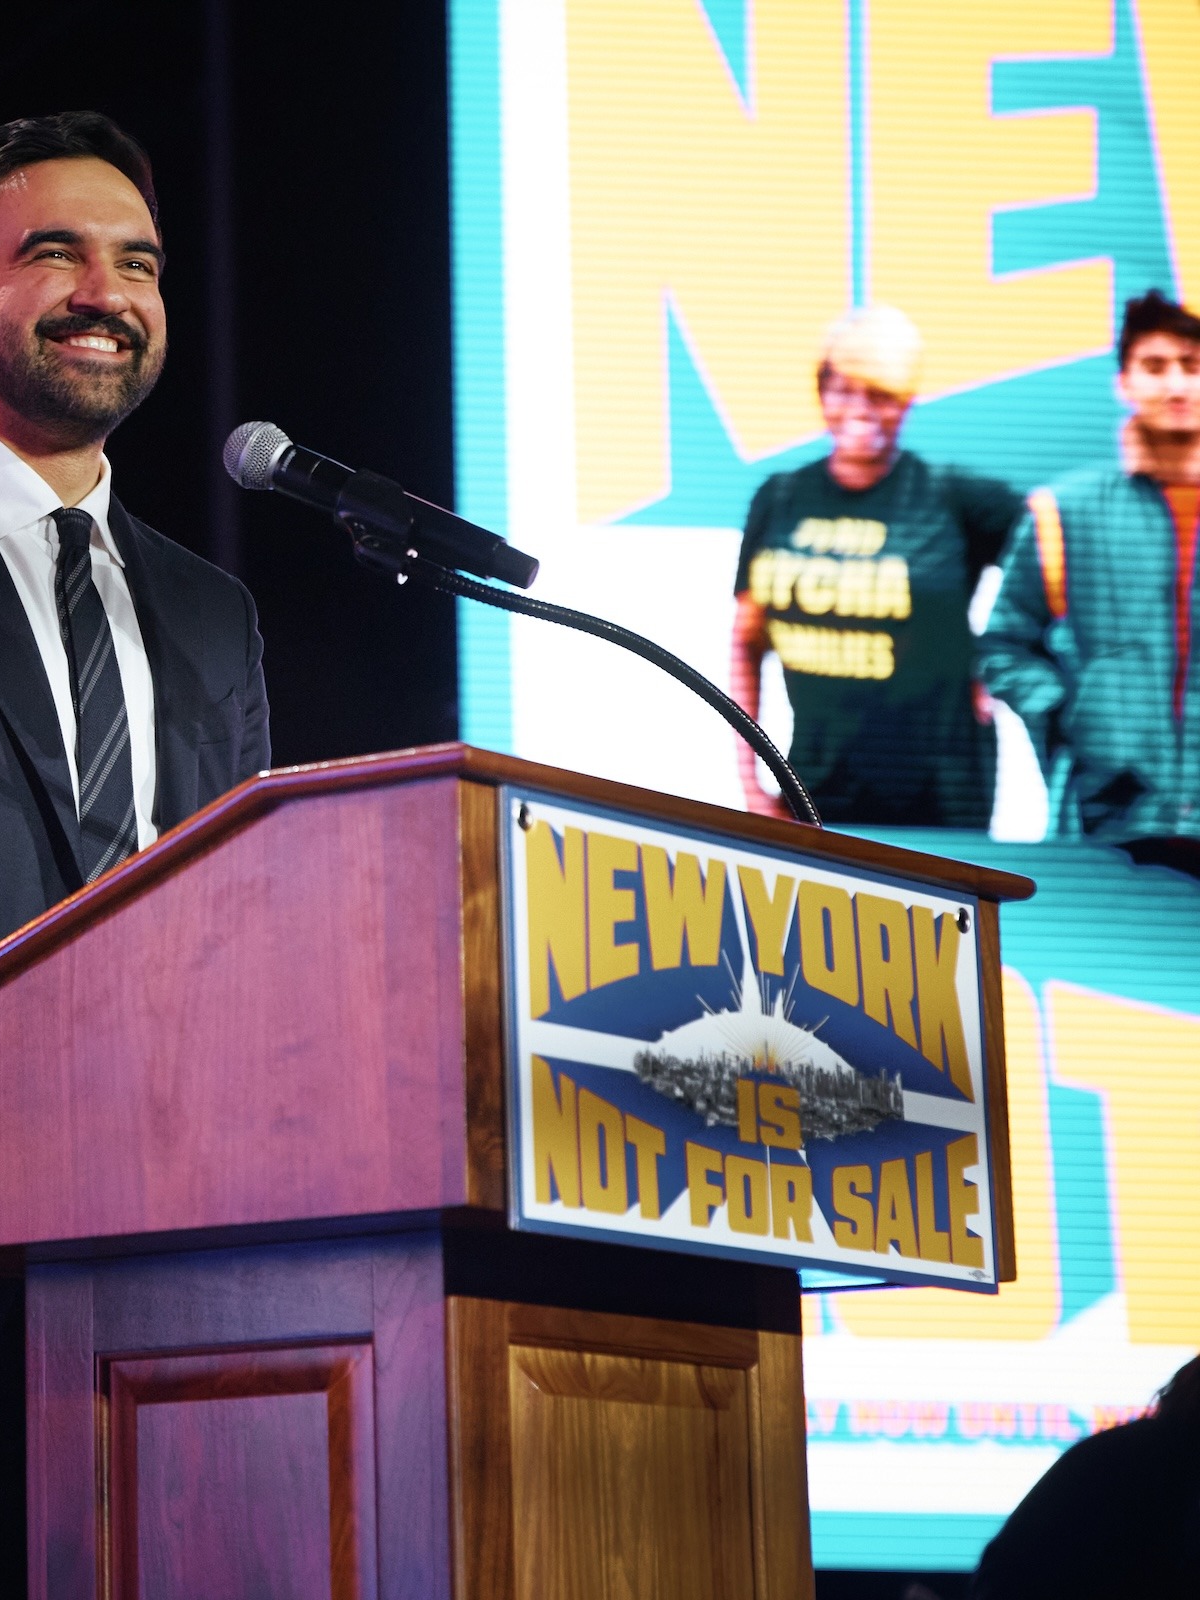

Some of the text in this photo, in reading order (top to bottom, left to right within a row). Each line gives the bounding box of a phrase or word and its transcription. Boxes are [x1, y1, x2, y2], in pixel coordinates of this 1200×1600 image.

[525, 819, 975, 1104] NEW YORK
[531, 1053, 985, 1269] NOT FOR SALE
[737, 1077, 803, 1151] IS
